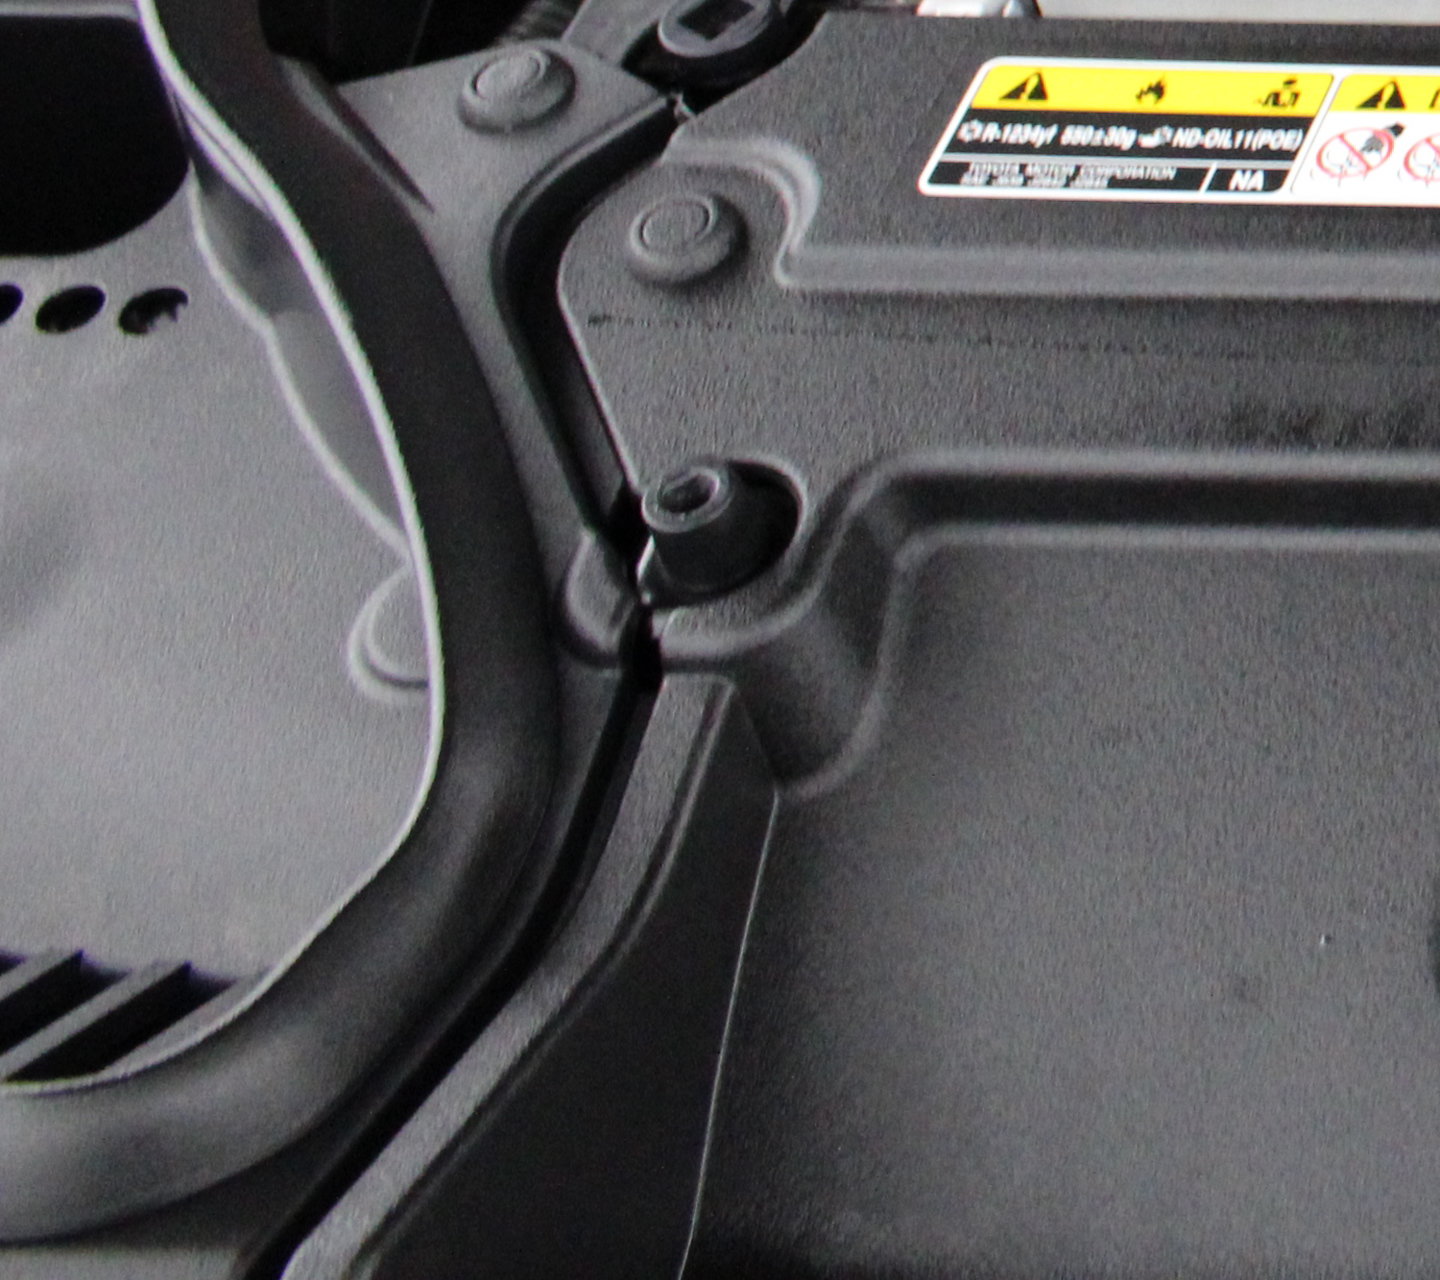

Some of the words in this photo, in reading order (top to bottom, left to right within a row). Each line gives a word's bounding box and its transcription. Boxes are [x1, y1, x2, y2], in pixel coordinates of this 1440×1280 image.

[1173, 127, 1303, 152] ND-OIL11(POE)
[969, 161, 1020, 176] TOYOTA
[1228, 169, 1265, 191] NA
